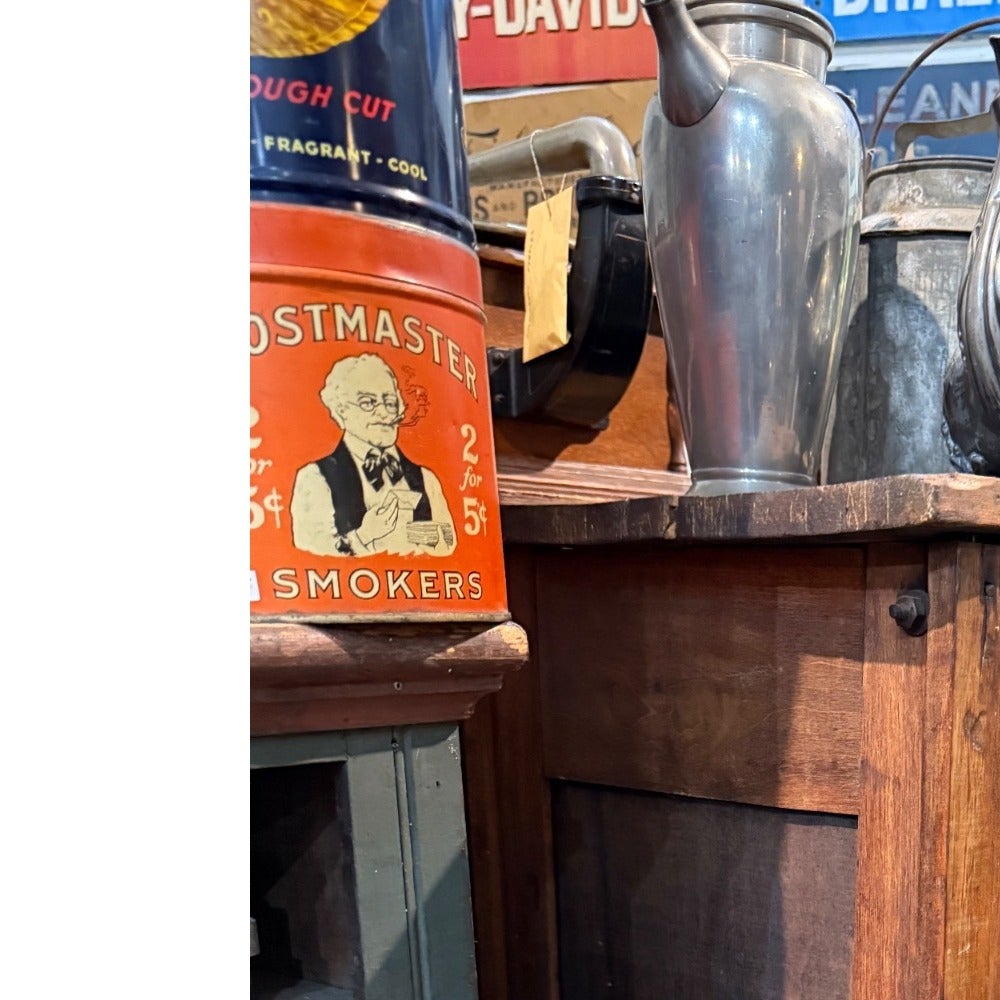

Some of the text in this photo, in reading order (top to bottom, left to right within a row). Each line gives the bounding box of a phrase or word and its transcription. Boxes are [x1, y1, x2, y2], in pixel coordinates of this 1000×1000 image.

[452, 0, 651, 39] Y-DAVID
[343, 90, 396, 123] CUT
[264, 135, 371, 165] FRAGRANT
[388, 157, 428, 181] COOL
[250, 302, 478, 402] OSTMASTER
[460, 423, 479, 465] 2
[459, 466, 482, 491] for
[272, 568, 483, 600] SMOKERS
